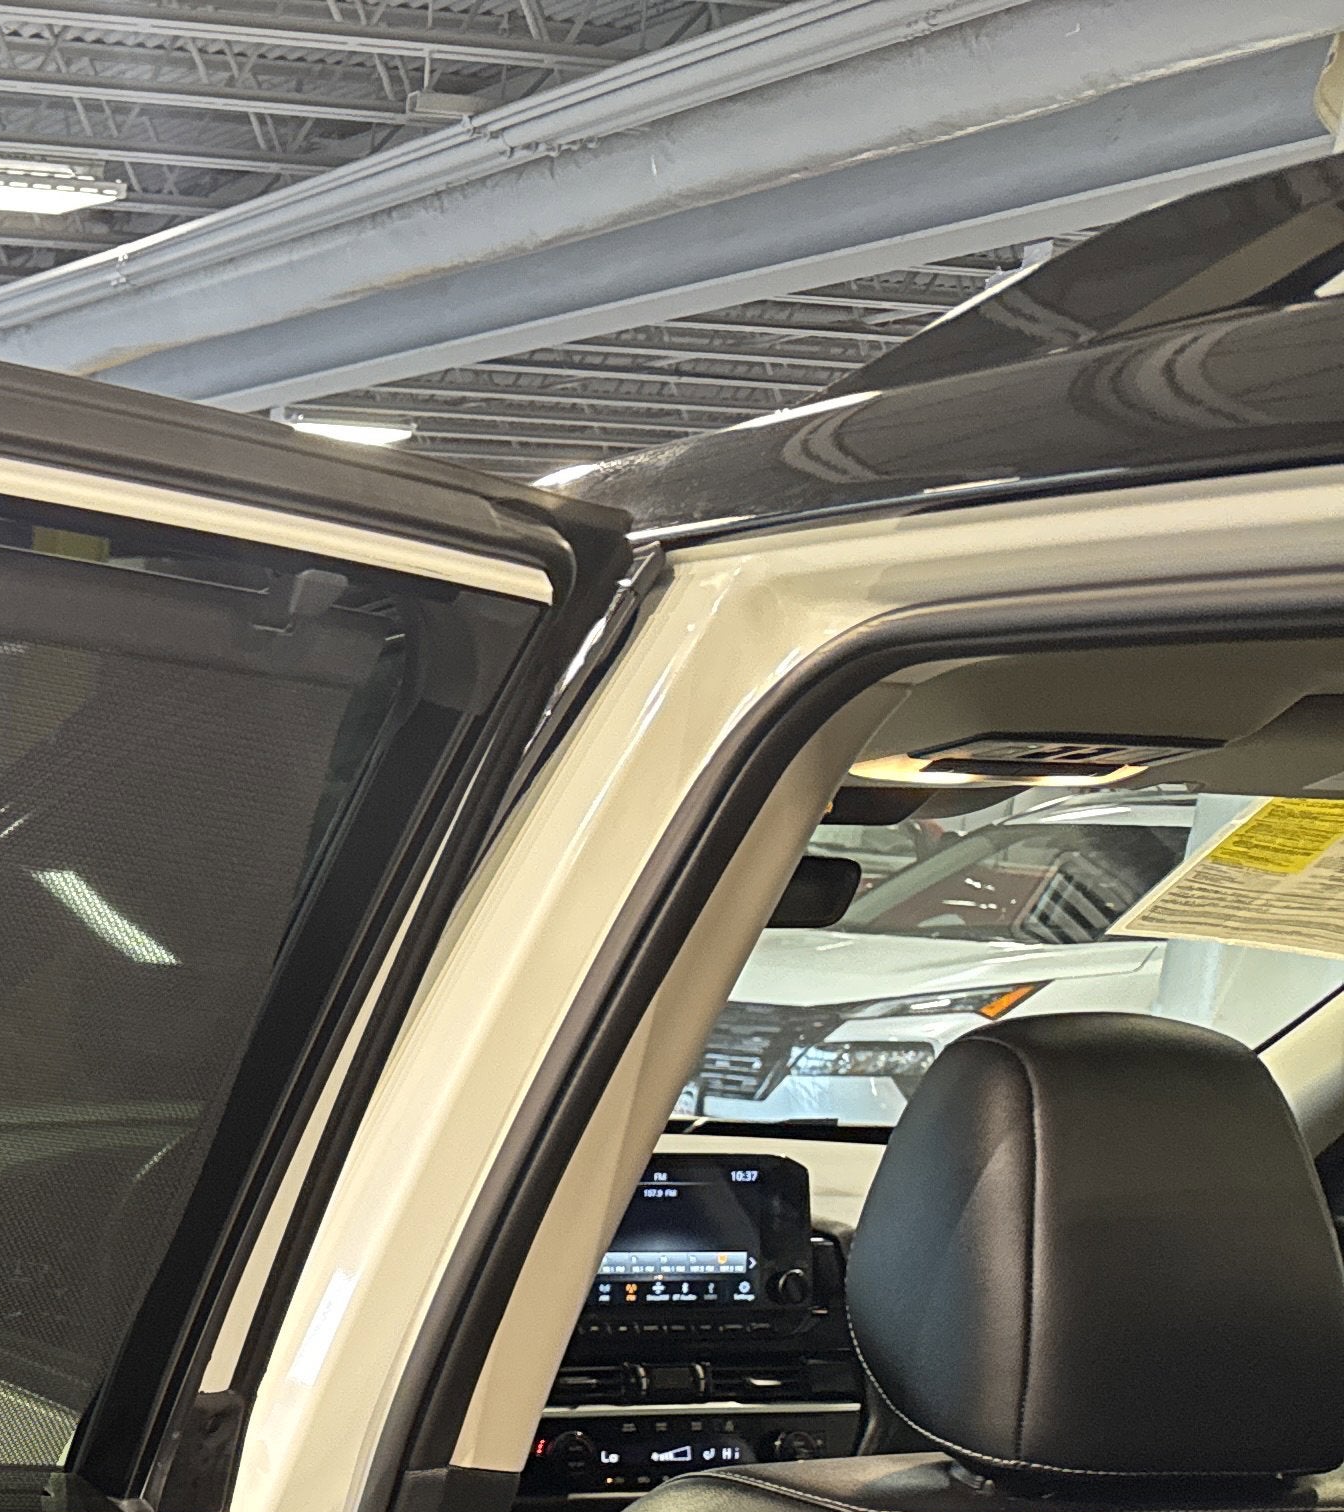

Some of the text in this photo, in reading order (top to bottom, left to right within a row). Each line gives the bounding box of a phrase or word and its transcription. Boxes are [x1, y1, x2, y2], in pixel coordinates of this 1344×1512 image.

[730, 1170, 759, 1182] 10:37
[600, 1450, 620, 1463] Lo
[721, 1446, 740, 1460] Hi
